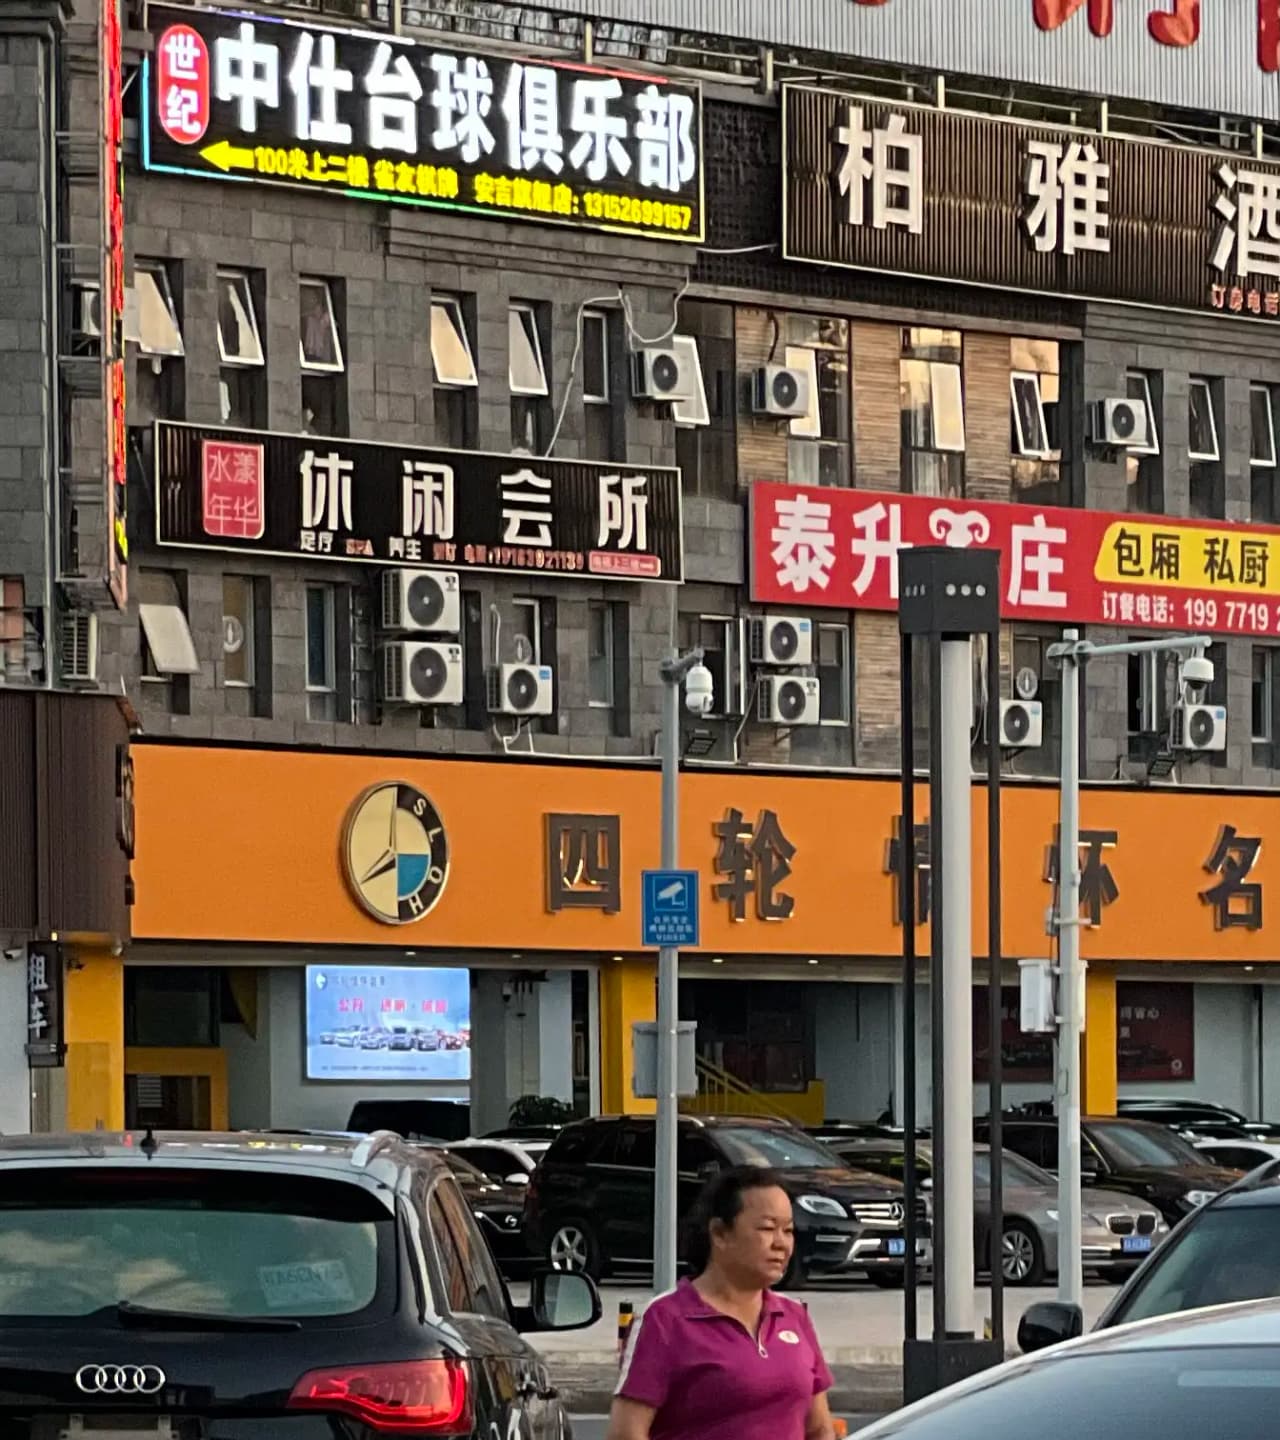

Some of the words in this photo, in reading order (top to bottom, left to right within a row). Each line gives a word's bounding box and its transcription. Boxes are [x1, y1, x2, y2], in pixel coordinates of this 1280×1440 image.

[165, 32, 201, 135] 世纪
[215, 21, 696, 193] 中仕台球俱乐部
[299, 450, 648, 551] 休闲会所
[1113, 527, 1181, 581] 包厢
[1203, 536, 1270, 589] 私厨
